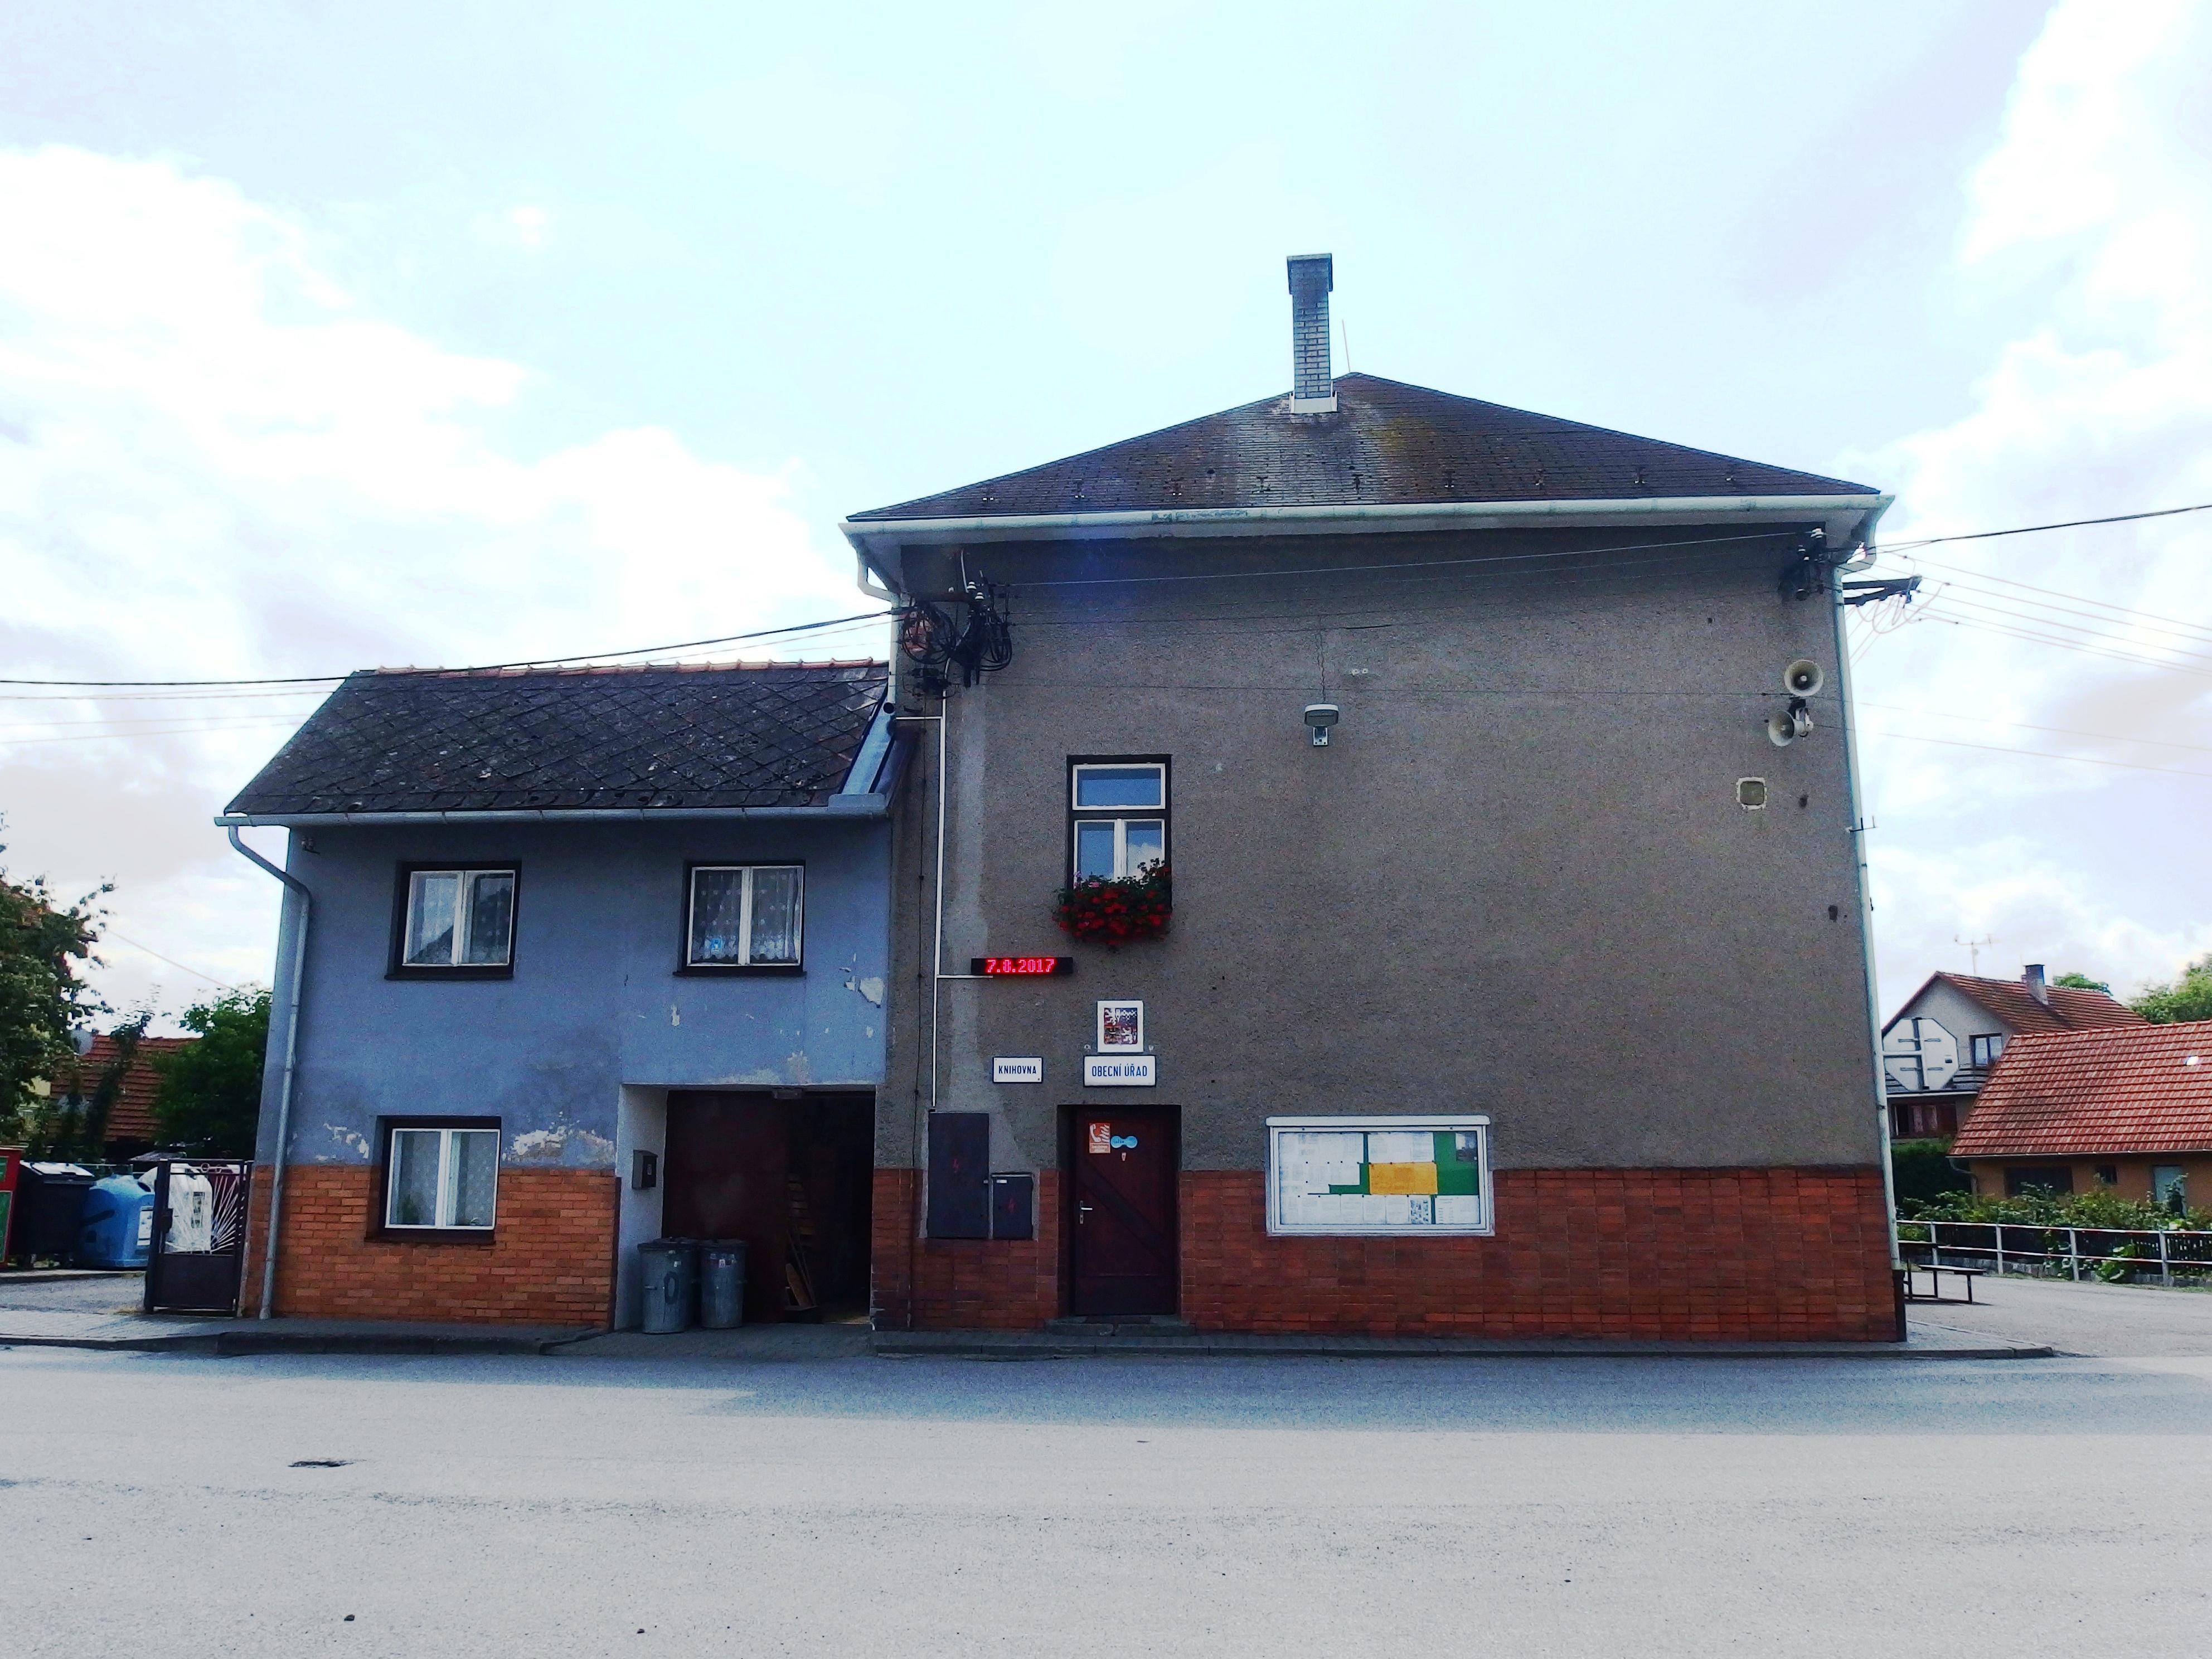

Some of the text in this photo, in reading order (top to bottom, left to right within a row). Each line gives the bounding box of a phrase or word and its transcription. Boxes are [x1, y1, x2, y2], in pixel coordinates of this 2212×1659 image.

[987, 959, 1054, 973] 7.8.2017
[998, 1065, 1037, 1074] KNIHOVNA
[1092, 1063, 1148, 1077] OBECNÍ ÚŘAD
